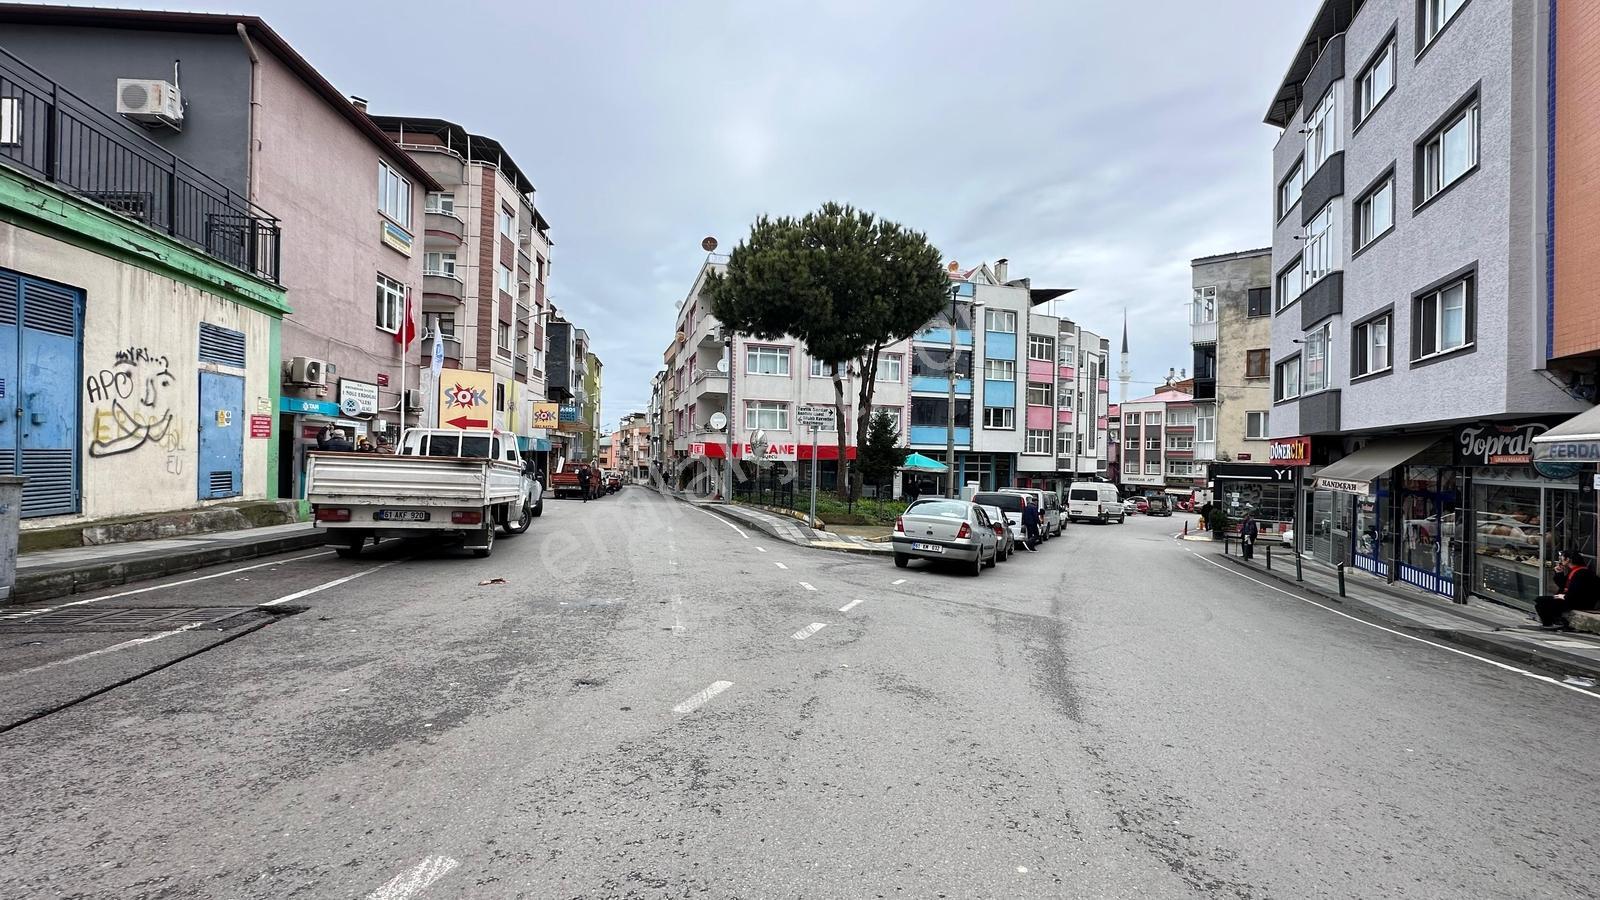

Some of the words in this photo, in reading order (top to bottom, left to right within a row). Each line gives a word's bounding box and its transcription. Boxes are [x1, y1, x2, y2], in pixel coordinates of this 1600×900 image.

[87, 369, 134, 403] APO
[444, 385, 488, 409] ŞOK
[745, 444, 795, 455] EANE
[1270, 440, 1305, 460] DÖNERCİM
[1460, 427, 1537, 465] Toprak
